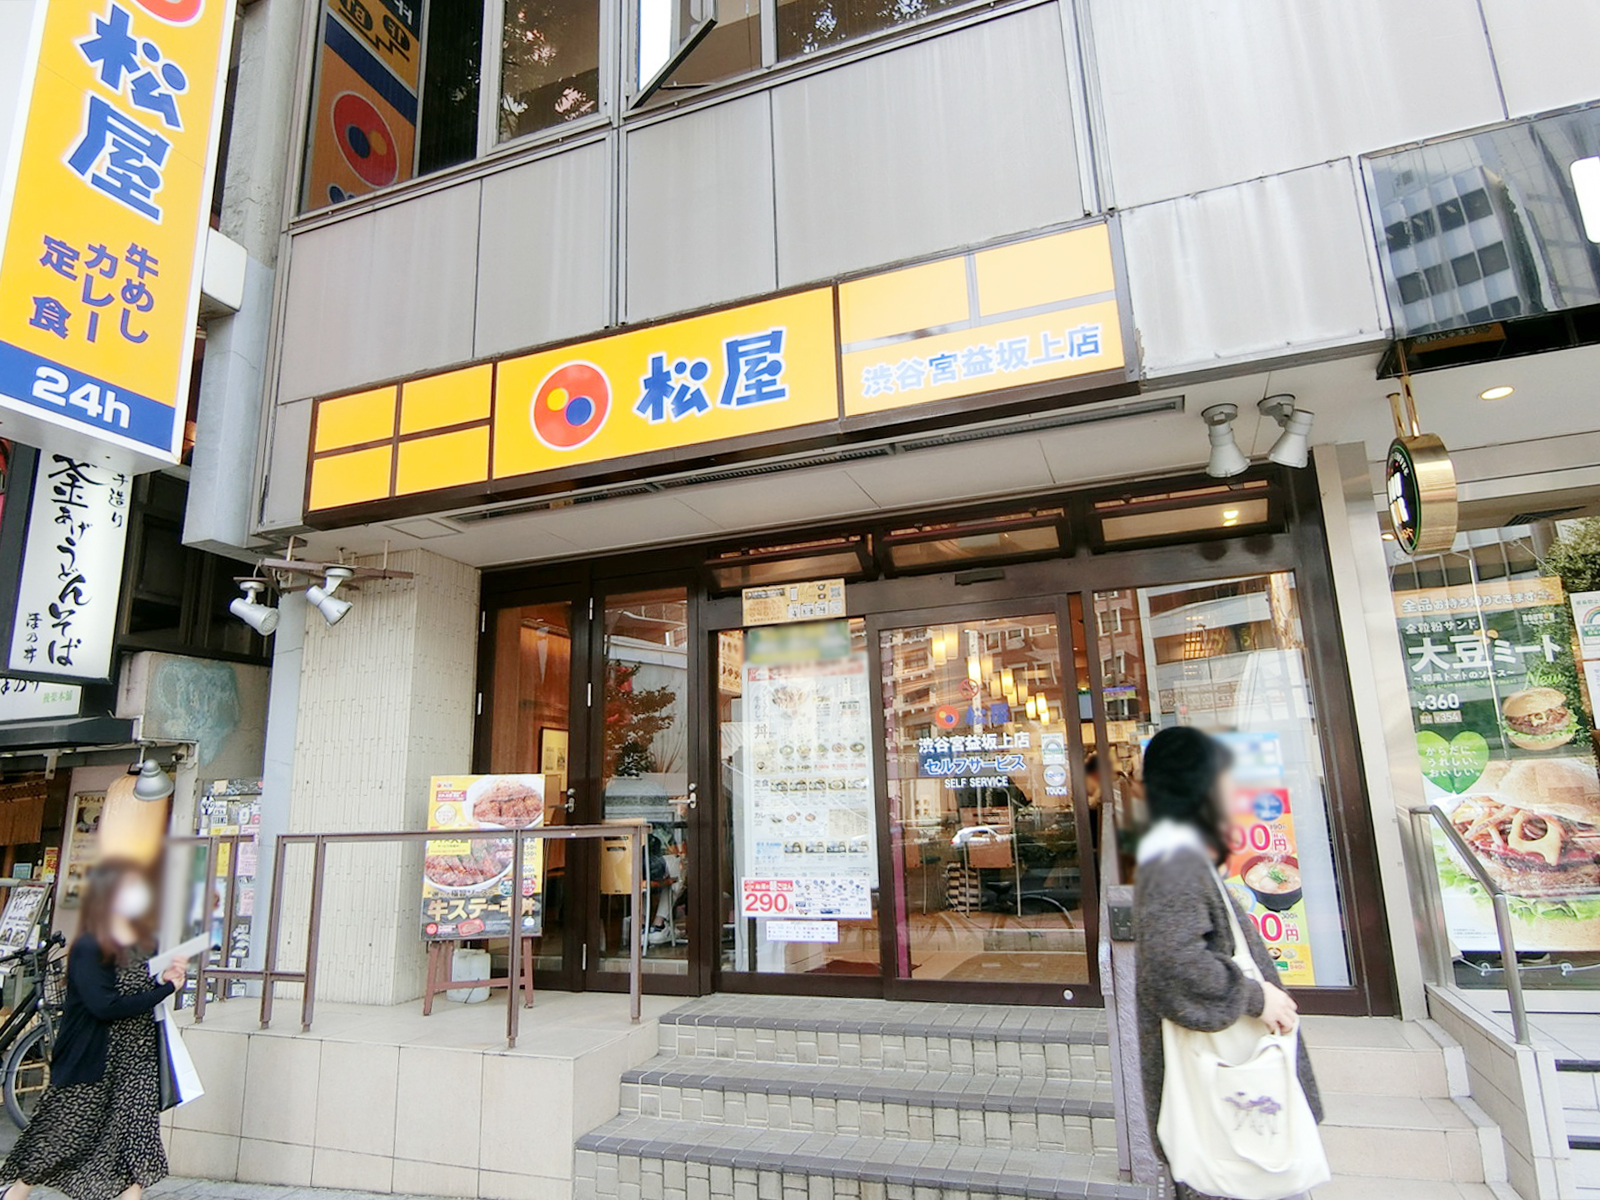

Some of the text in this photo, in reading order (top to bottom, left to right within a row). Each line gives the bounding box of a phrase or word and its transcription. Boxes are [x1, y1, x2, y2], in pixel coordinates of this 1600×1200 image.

[68, 3, 187, 221] 松屋
[29, 235, 81, 339] 定食
[120, 242, 160, 344] 牛めし
[637, 330, 789, 421] 松屋
[861, 325, 1101, 397] 渋谷宮益坂上店
[32, 366, 131, 429] 24h
[1408, 634, 1562, 673] 大豆ミート
[1417, 693, 1460, 711] ¥360
[918, 732, 1031, 754] 渋谷宮益坂上店
[924, 754, 1027, 776] セルフサービス
[944, 775, 1009, 789] SELF SERVICE
